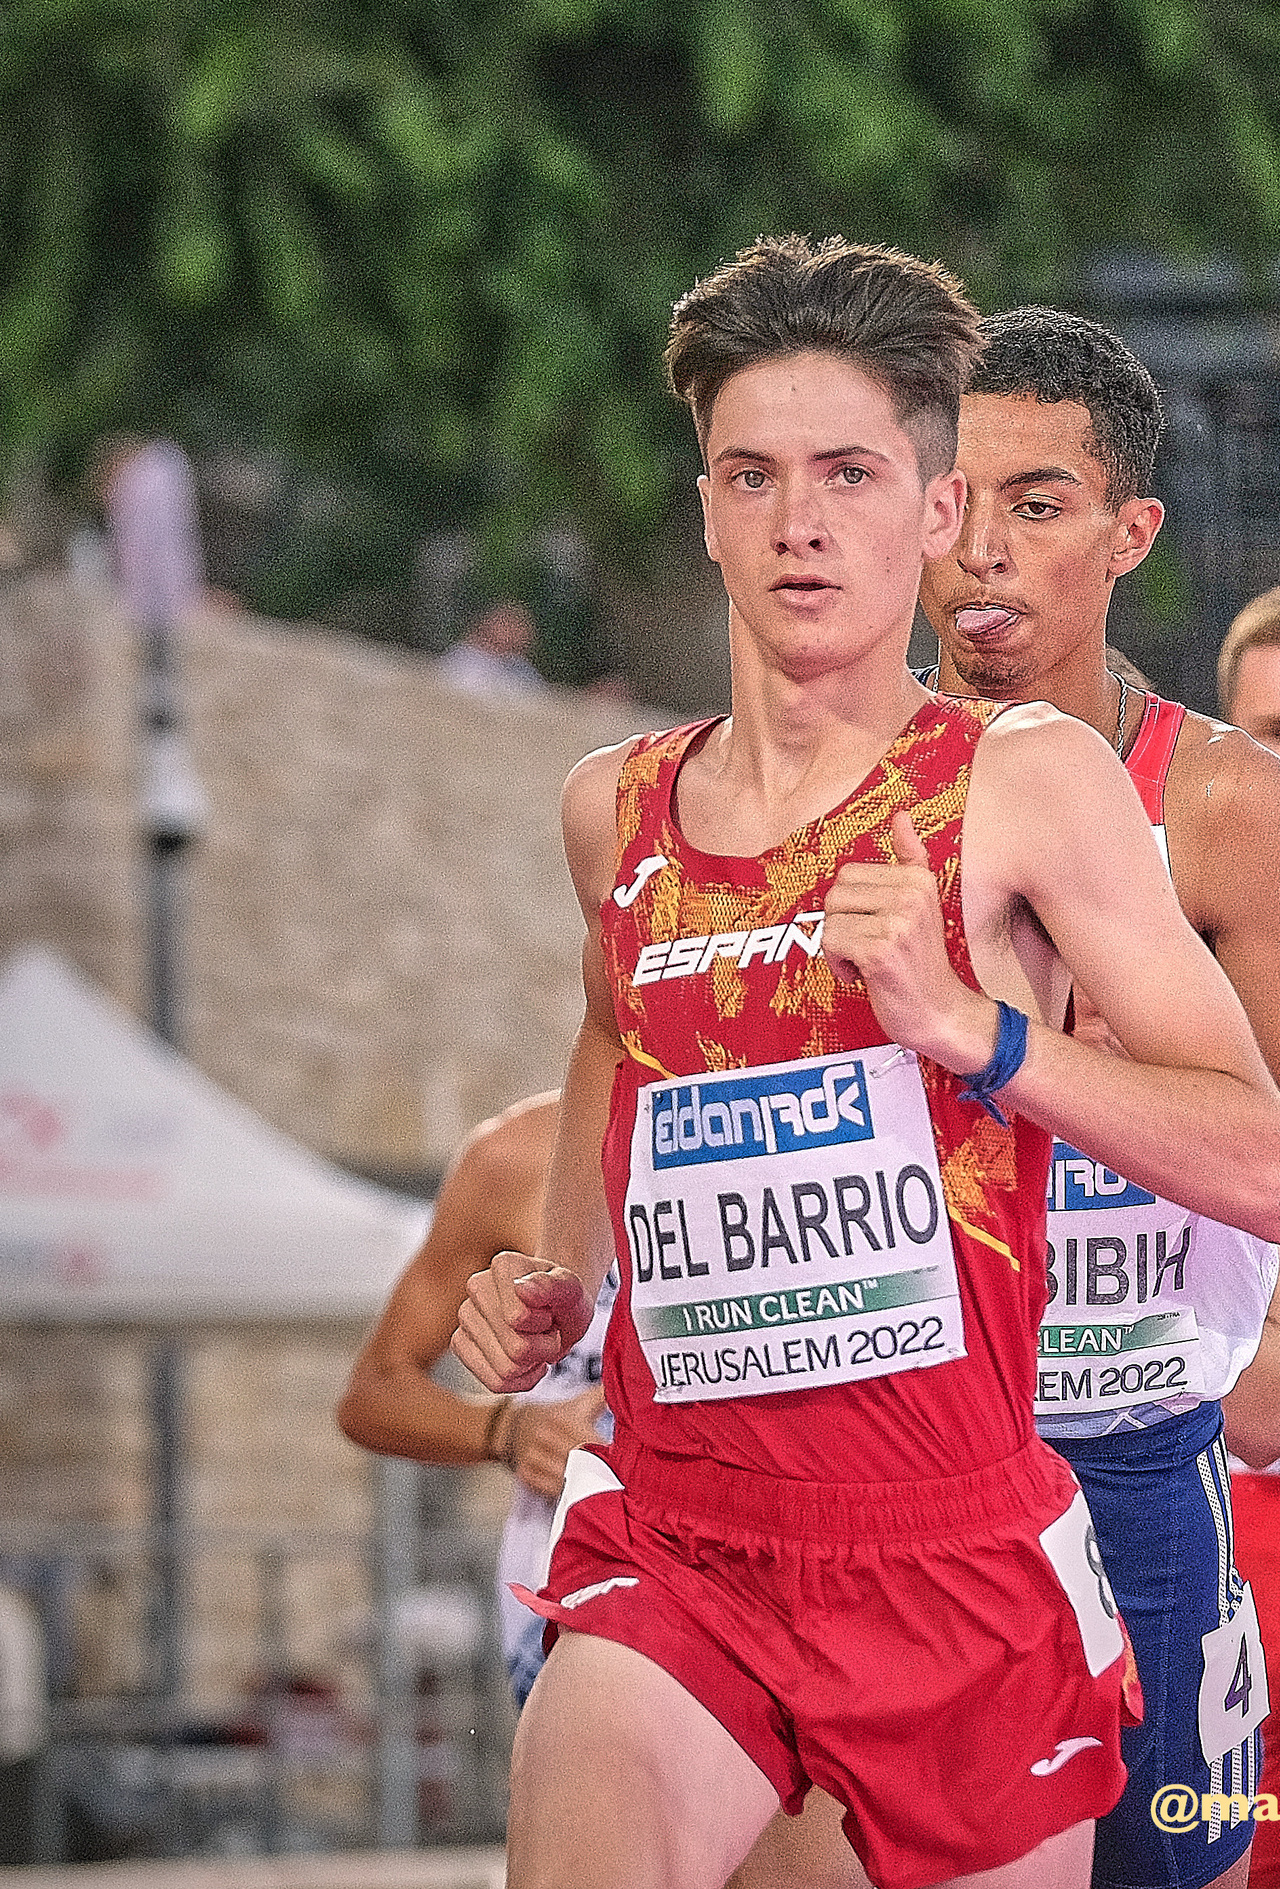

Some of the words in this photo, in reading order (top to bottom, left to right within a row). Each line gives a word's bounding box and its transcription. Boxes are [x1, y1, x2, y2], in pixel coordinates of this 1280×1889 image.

[630, 1198, 709, 1284] DEL
[717, 1163, 940, 1273] BARRIO
[659, 1335, 844, 1388] JERUSALEM
[849, 1315, 946, 1365] 2022
[683, 1305, 693, 1332] I
[697, 1298, 754, 1331] RUN
[1033, 1366, 1093, 1402] EM
[1099, 1356, 1188, 1397] 2022
[1224, 1630, 1254, 1719] 4
